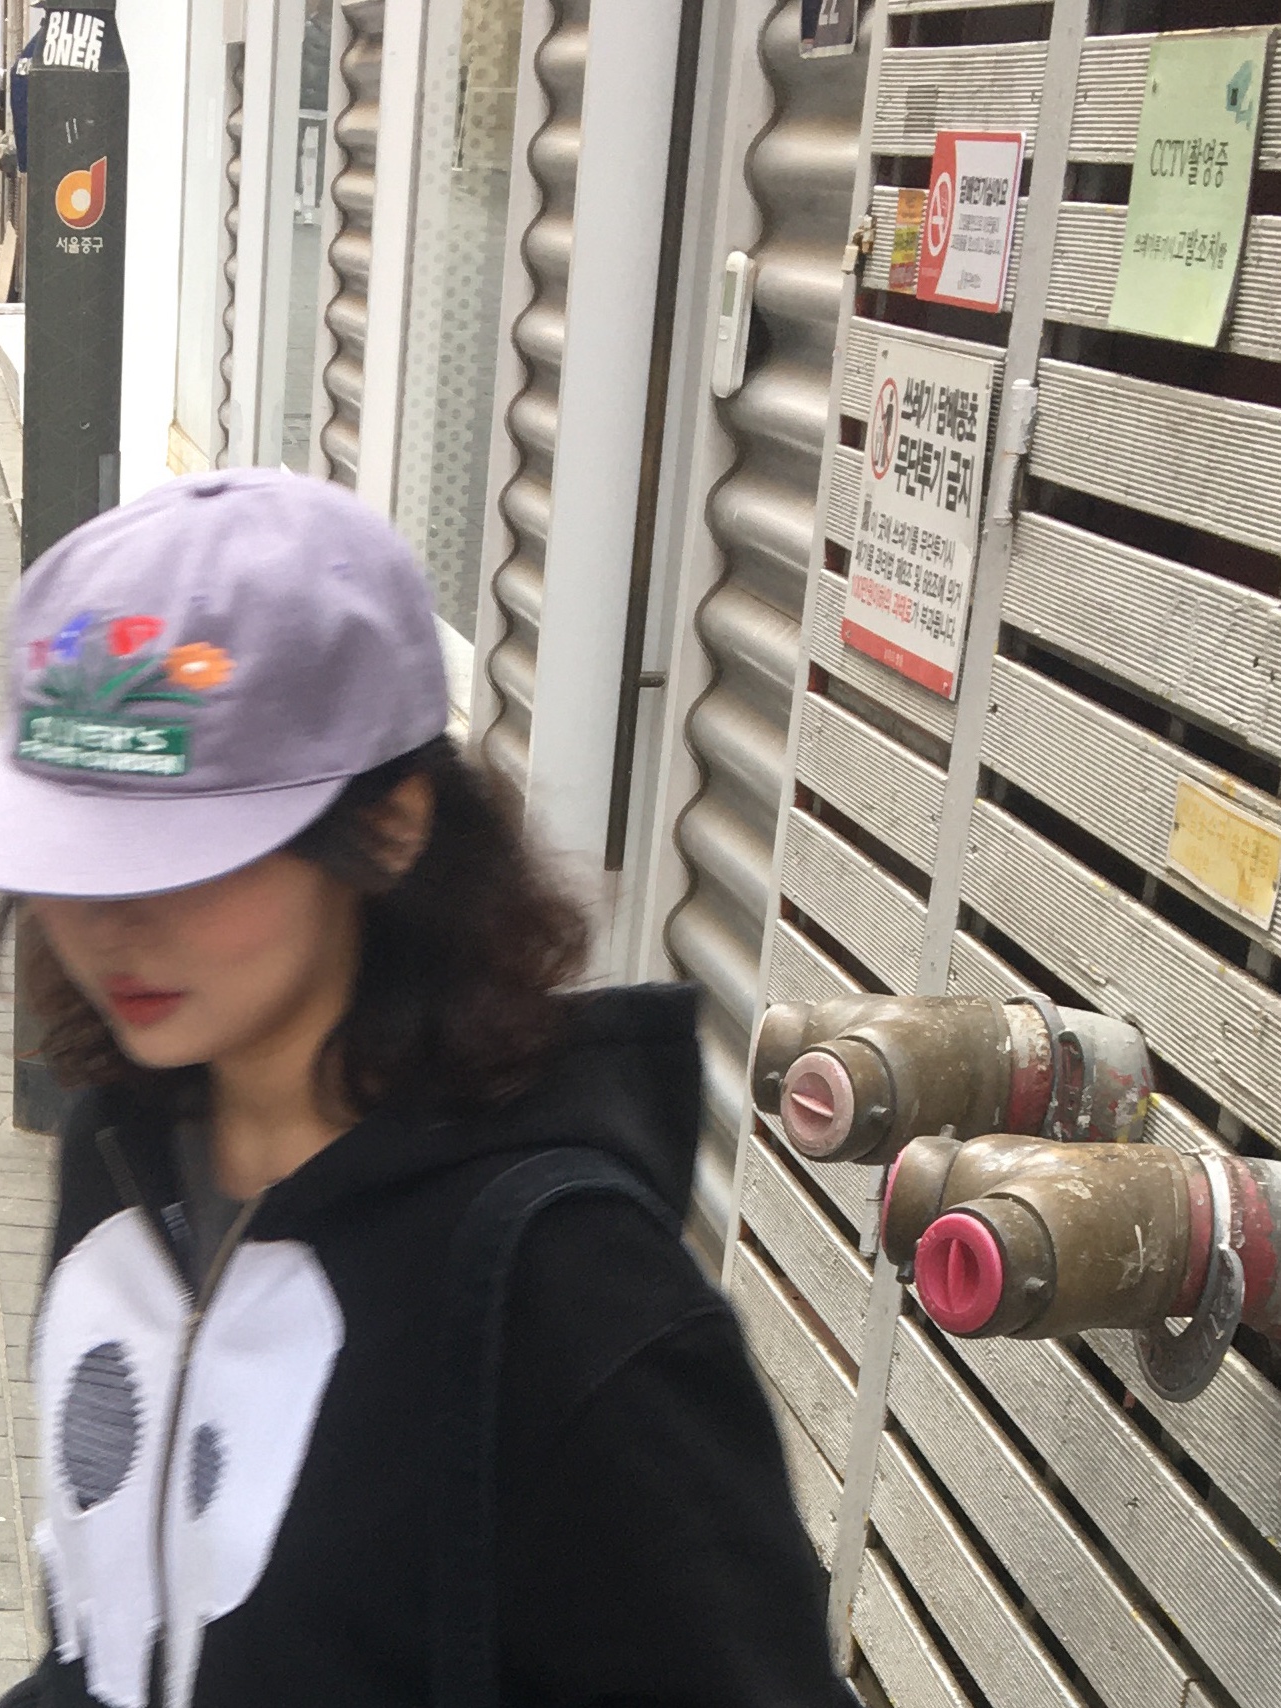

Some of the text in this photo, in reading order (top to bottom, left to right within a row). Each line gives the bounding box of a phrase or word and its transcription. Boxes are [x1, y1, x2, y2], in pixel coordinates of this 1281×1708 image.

[46, 10, 105, 43] BLUE
[43, 38, 102, 73] ONER
[1150, 138, 1229, 188] CCTV촬영중
[56, 236, 104, 255] 서울중구
[894, 434, 976, 519] 무단투기 금지
